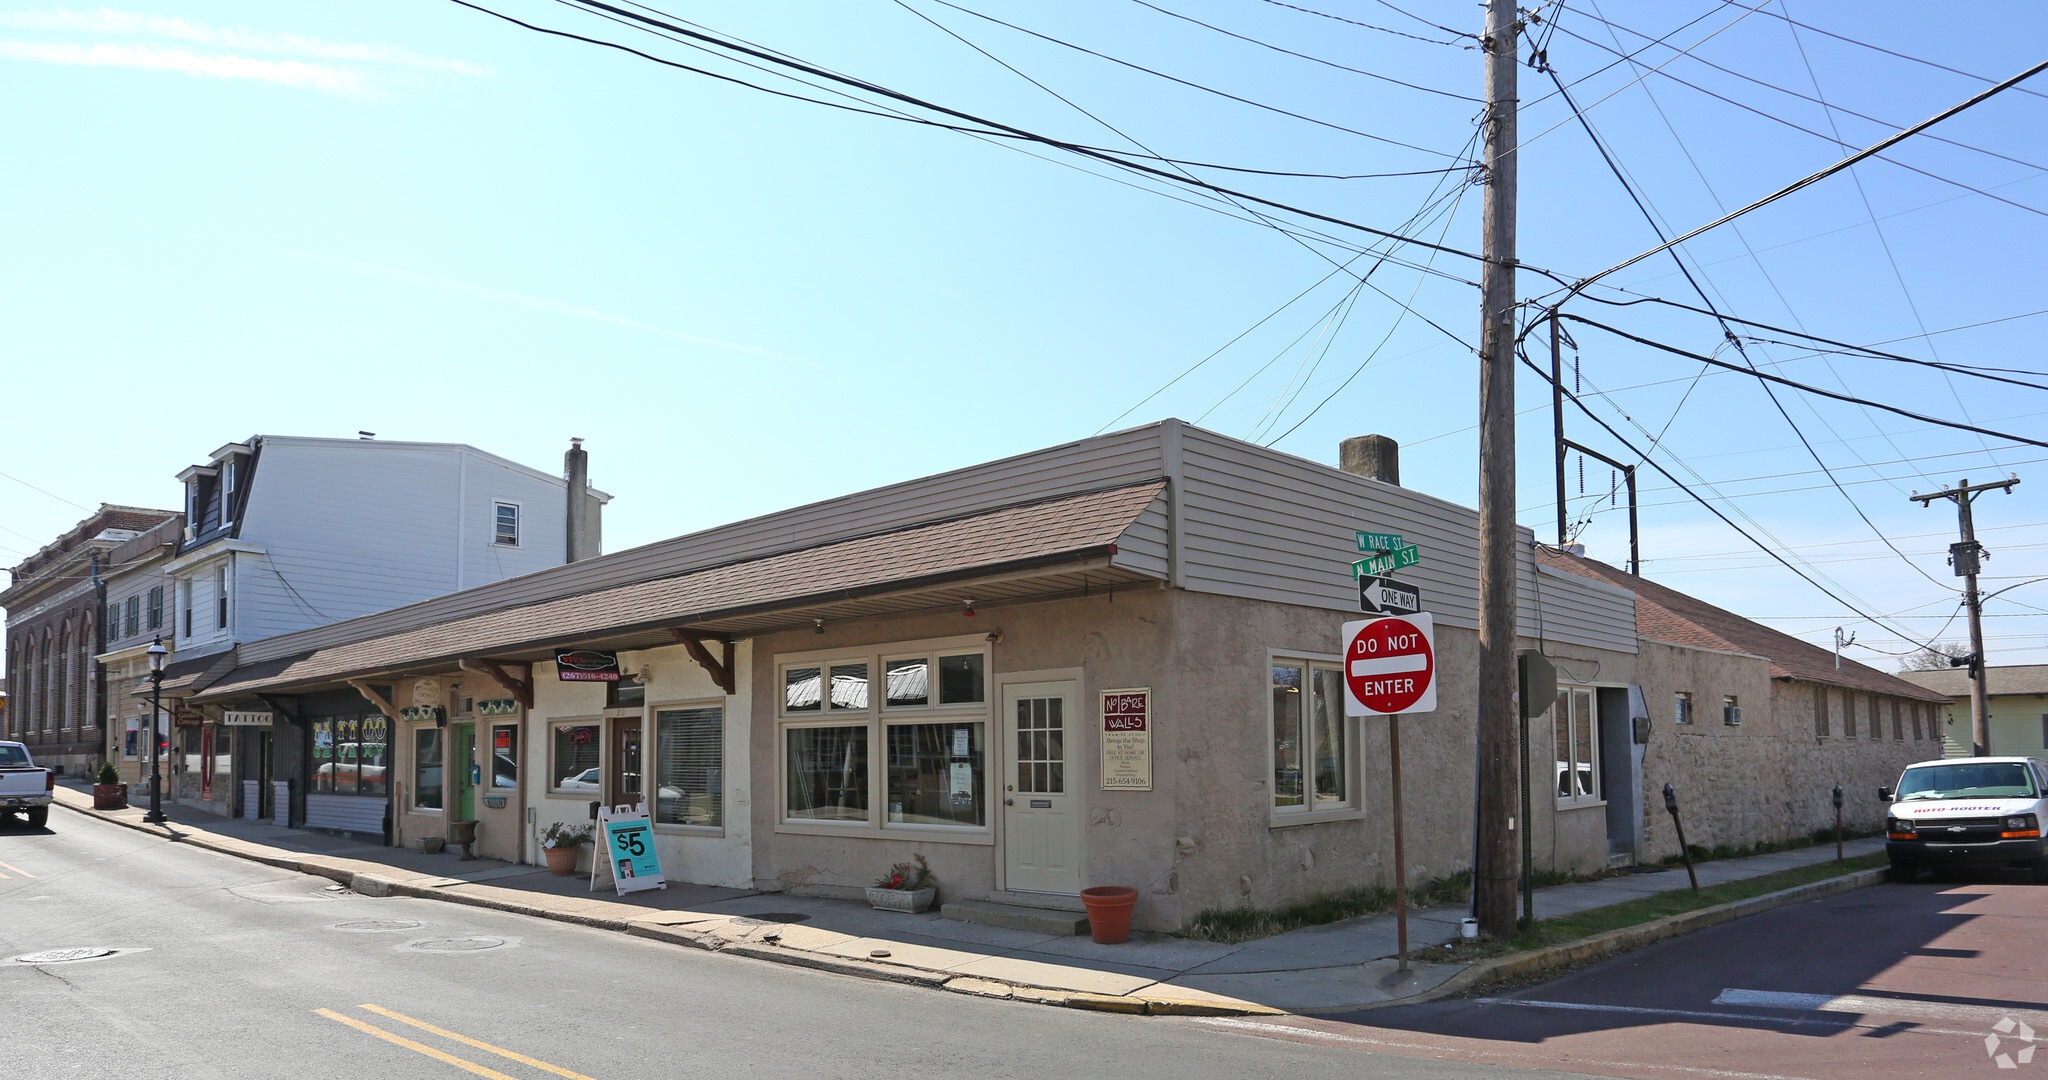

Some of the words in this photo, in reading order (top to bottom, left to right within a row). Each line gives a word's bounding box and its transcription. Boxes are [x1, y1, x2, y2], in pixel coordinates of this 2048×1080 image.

[1357, 534, 1366, 548] W
[1369, 535, 1391, 550] RACE
[1392, 537, 1402, 551] ST
[1356, 563, 1364, 576] N
[1369, 554, 1396, 575] MAIN
[1401, 548, 1415, 565] ST
[1381, 588, 1399, 605] ONE
[1399, 592, 1415, 609] WAY
[1357, 638, 1378, 654] DO
[1387, 633, 1418, 651] NOT
[562, 655, 585, 664] VIVA
[1364, 678, 1414, 696] ENTER
[1120, 696, 1144, 712] BARE
[226, 714, 272, 723] TATTOO
[1108, 716, 1143, 729] WALLS
[314, 717, 387, 740] TATTOO
[570, 730, 592, 745] OPEN
[1105, 777, 1146, 785] 215-654-9106
[1913, 806, 2001, 814] ROTO-ROOTER
[617, 832, 645, 857] $5
